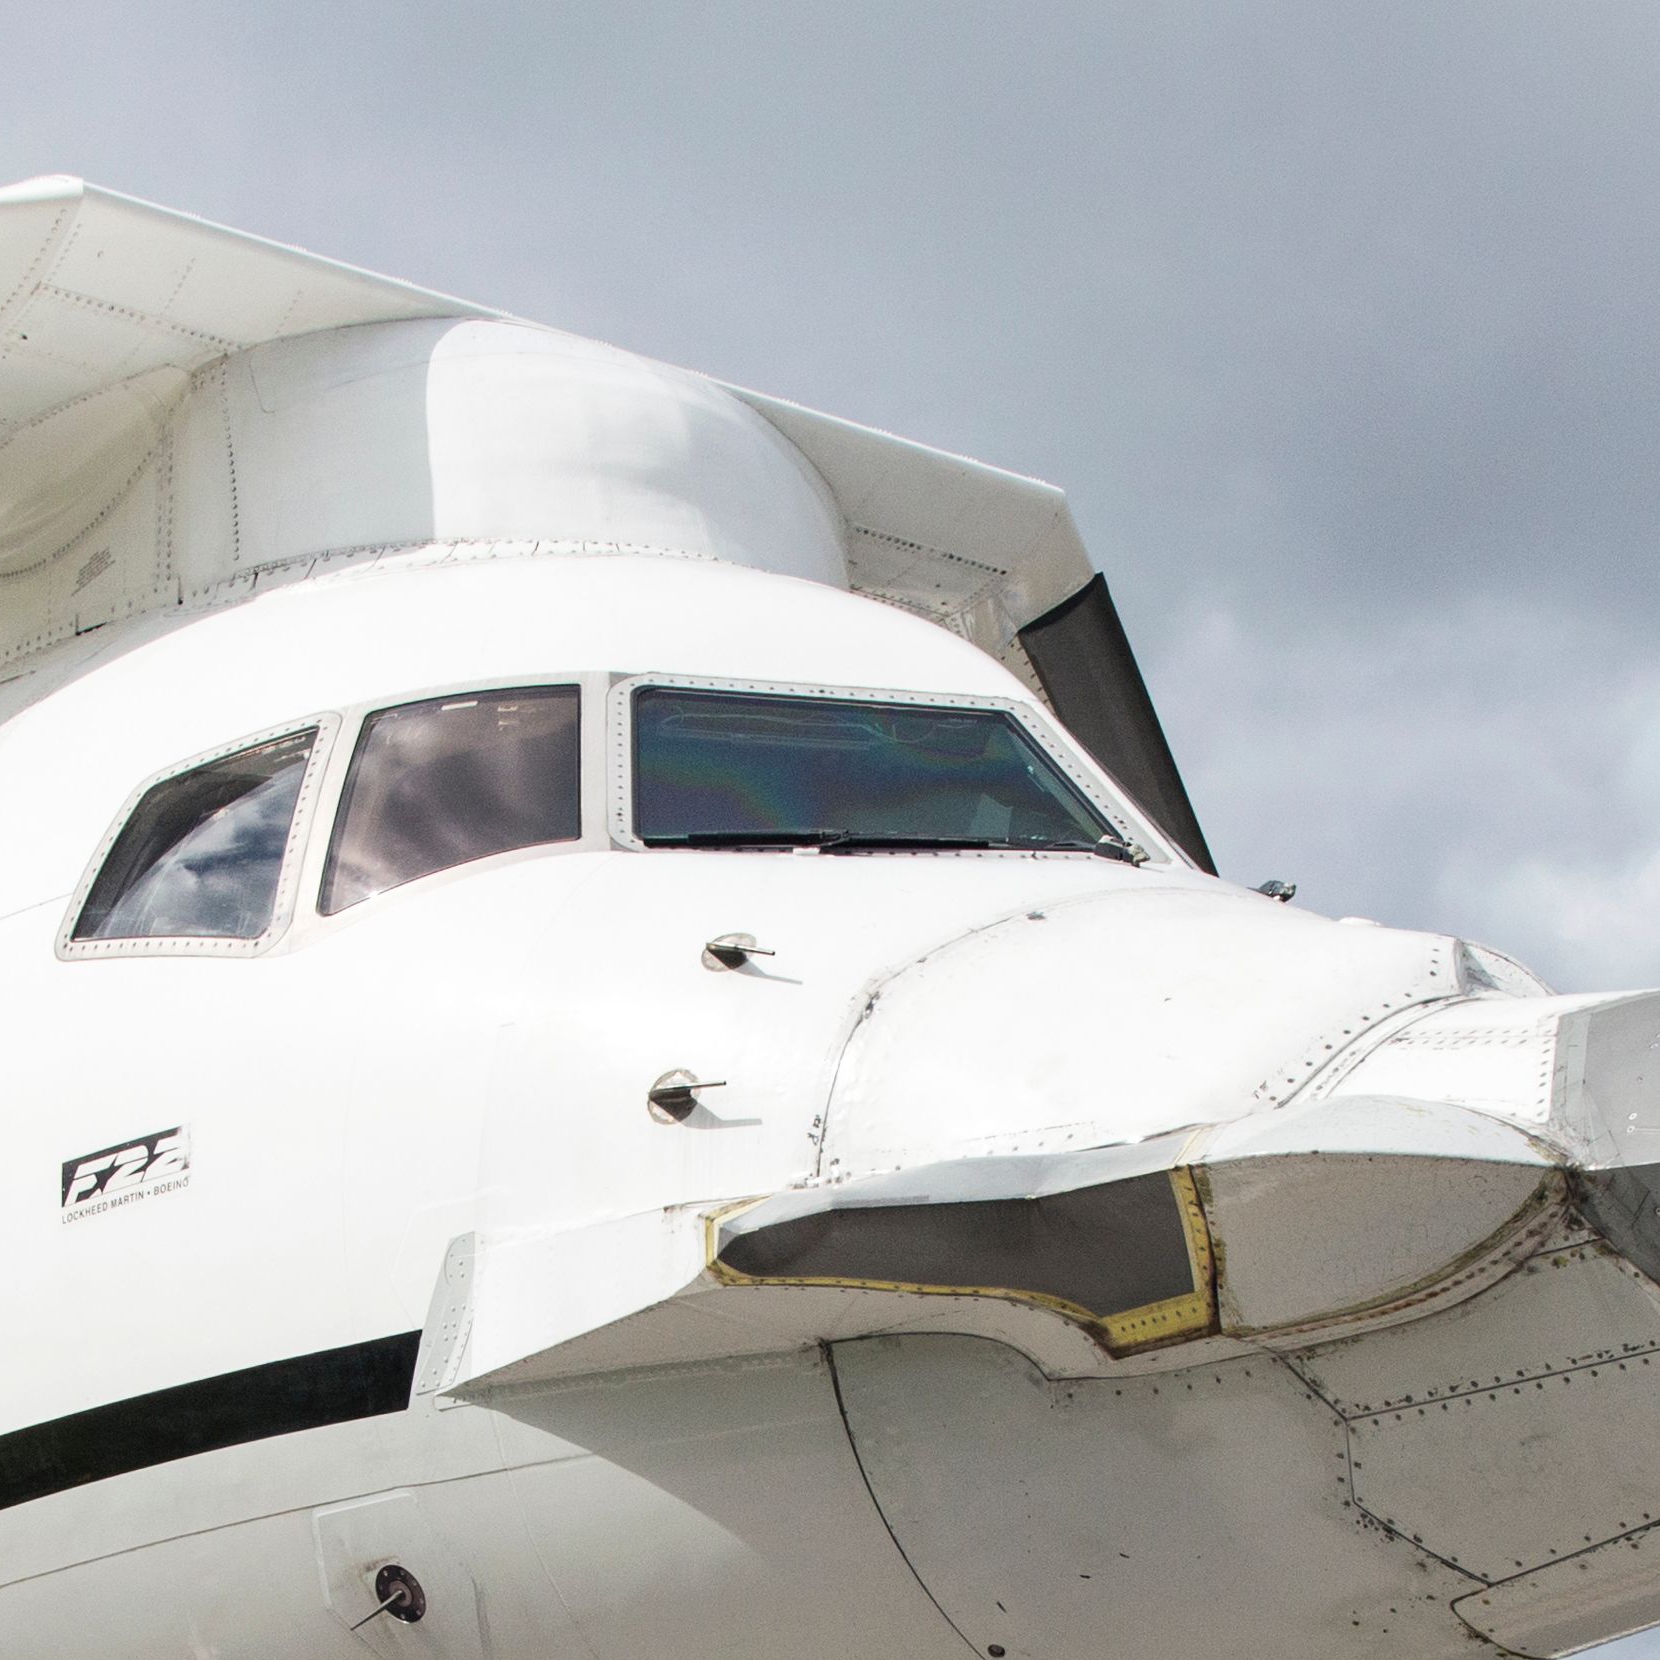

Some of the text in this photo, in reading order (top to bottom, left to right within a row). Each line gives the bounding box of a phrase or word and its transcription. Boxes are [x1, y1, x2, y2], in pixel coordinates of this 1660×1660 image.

[62, 1177, 190, 1224] LOCKHEED MARTIN BOEING
